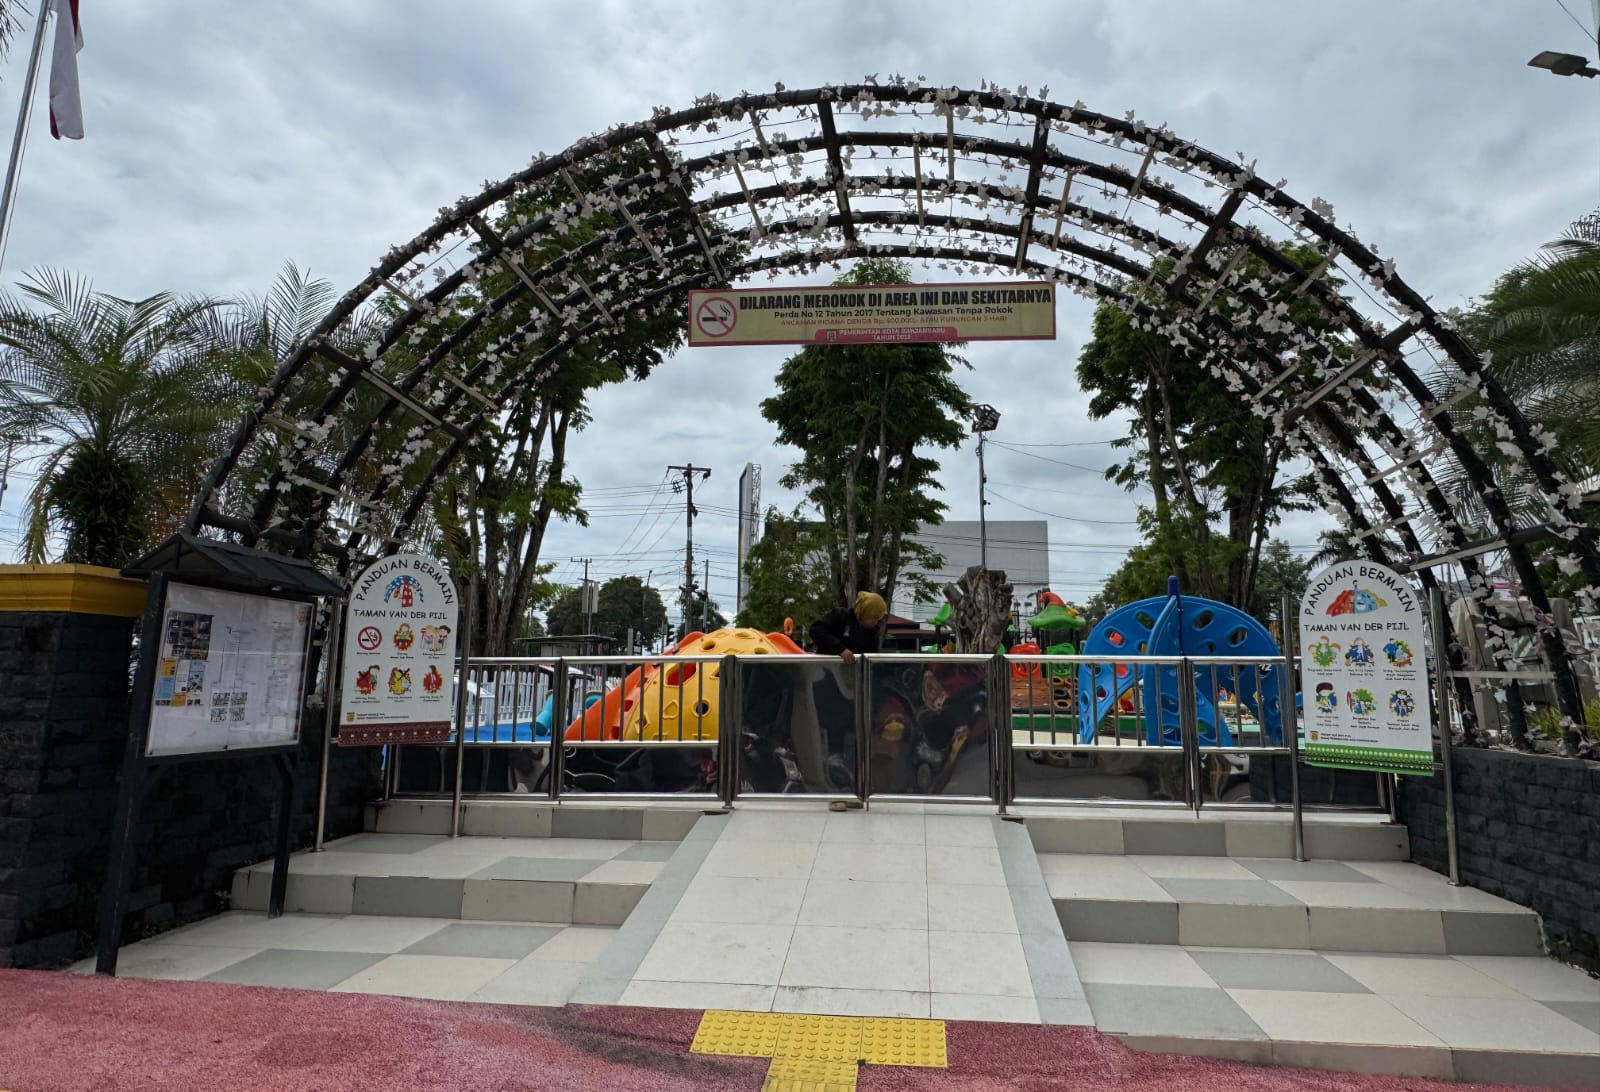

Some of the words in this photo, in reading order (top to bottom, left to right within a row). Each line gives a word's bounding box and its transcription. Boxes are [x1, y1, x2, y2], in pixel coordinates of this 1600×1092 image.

[739, 294, 801, 310] DILARANG
[803, 293, 866, 308] MEROKOK
[868, 292, 882, 307] DI
[884, 291, 918, 306] AREA
[920, 291, 939, 306] INI
[941, 290, 968, 305] DAN
[971, 289, 1052, 305] SEKITARNYA
[855, 309, 873, 317] 2017
[876, 309, 911, 317] Tentang
[956, 306, 982, 315] Tanpa
[985, 306, 1013, 314] Rokok
[356, 559, 408, 601] PANDUAN
[413, 560, 455, 605] BERMAIN
[1304, 566, 1354, 615] PANDUAN
[1359, 566, 1415, 613] BERMAIN
[354, 609, 386, 618] TAMAN
[410, 611, 426, 619] DER
[429, 612, 448, 620] PIJL
[1303, 624, 1337, 632] TAMAN
[1340, 623, 1361, 631] VAN
[1364, 622, 1383, 631] DER
[1386, 622, 1410, 631] PIJL
